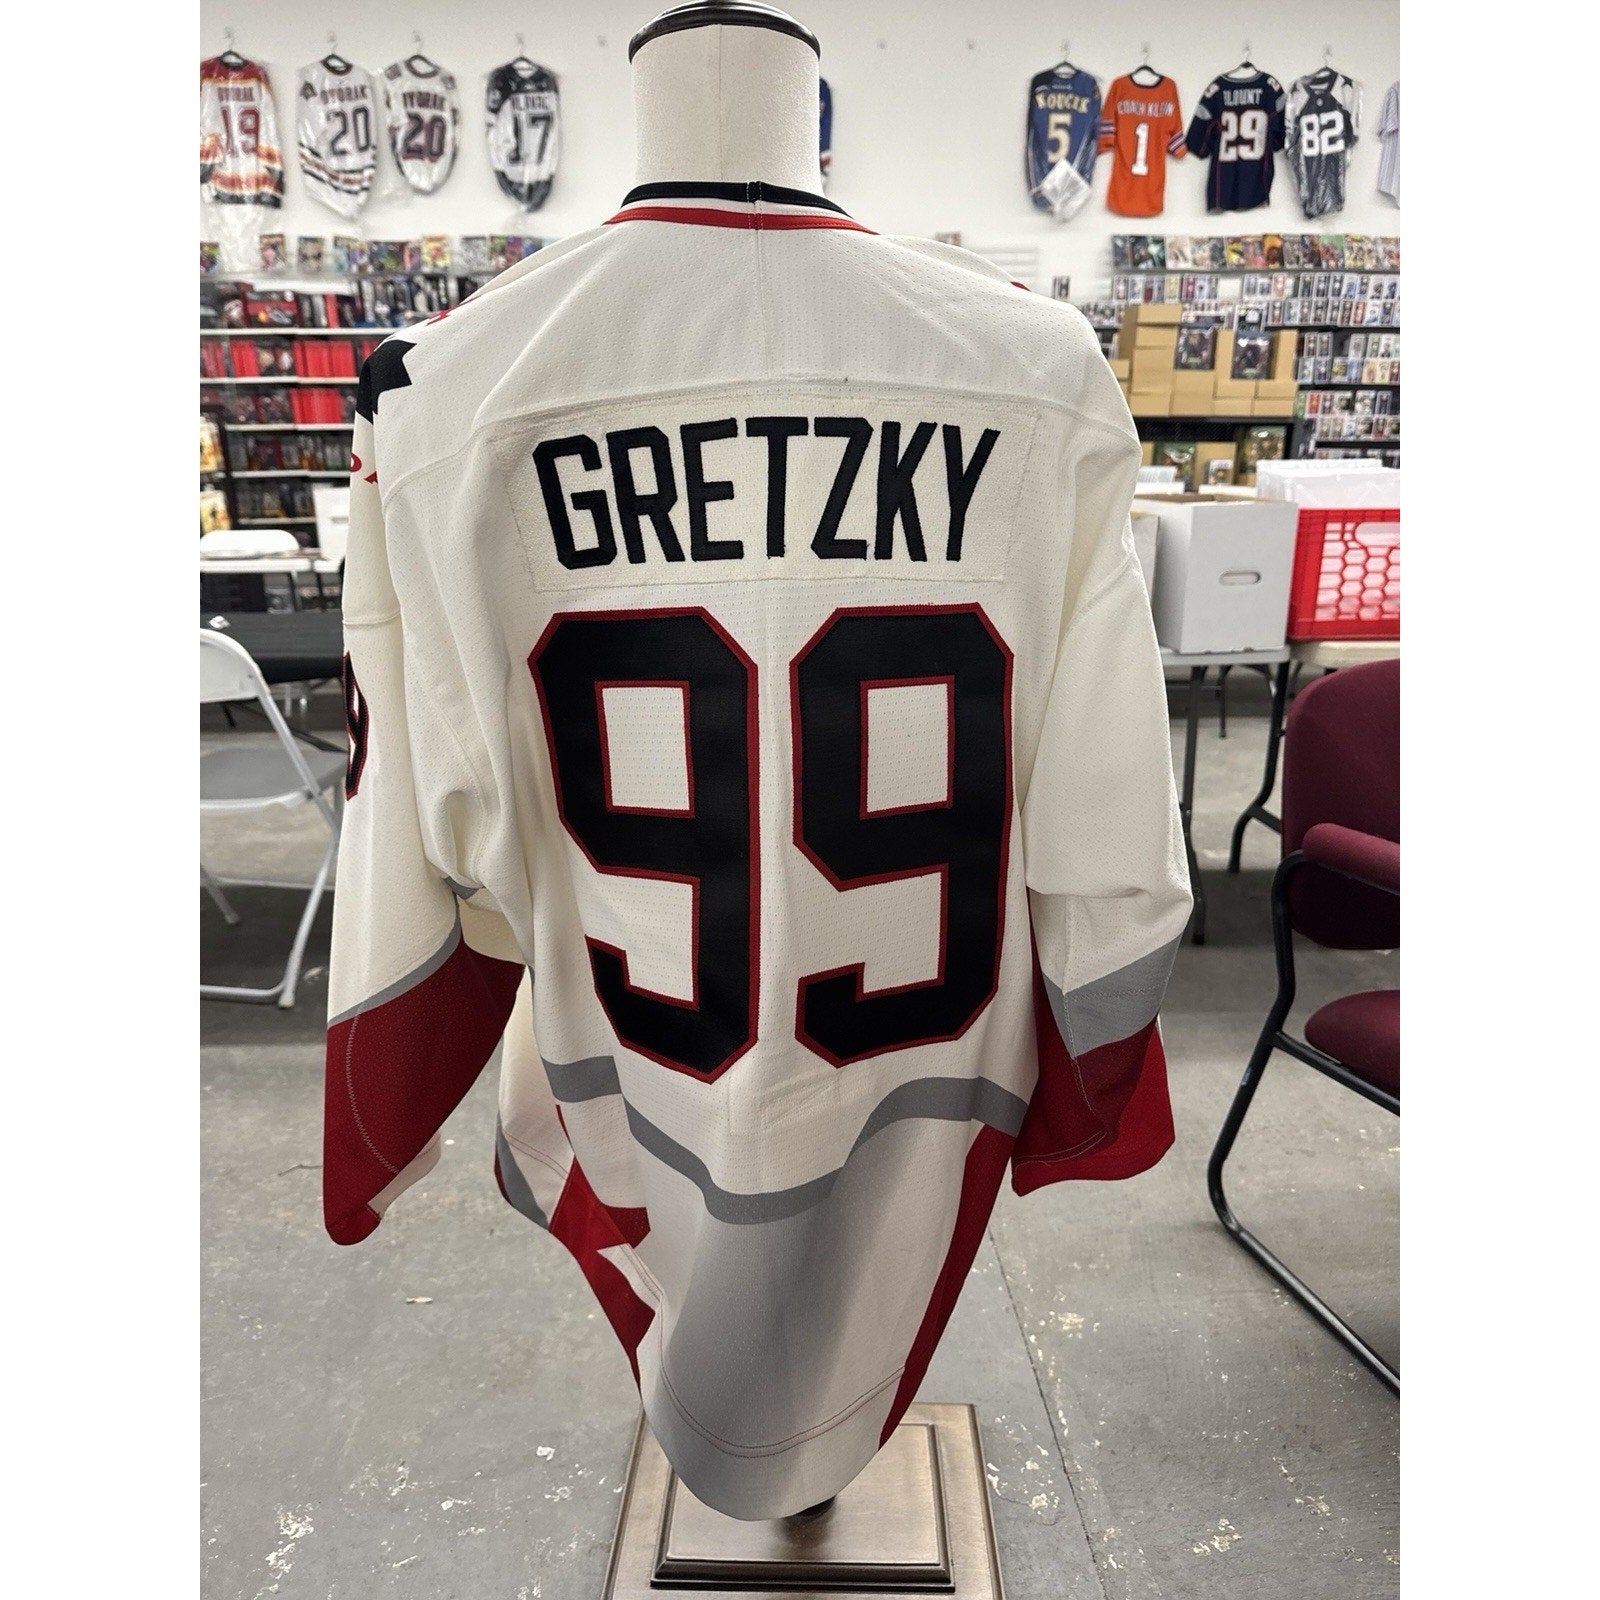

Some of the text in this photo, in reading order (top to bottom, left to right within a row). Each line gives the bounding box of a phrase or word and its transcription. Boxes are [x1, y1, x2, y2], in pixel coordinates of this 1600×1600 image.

[220, 106, 261, 158] 19
[325, 106, 370, 156] 20
[402, 112, 447, 162] 20
[508, 112, 554, 166] 17
[1047, 113, 1072, 163] 5
[1131, 122, 1150, 176] 1
[1218, 109, 1269, 162] 29
[1301, 110, 1345, 157] 82
[532, 416, 1001, 570] GRETZKY
[526, 601, 1014, 1086] 99
